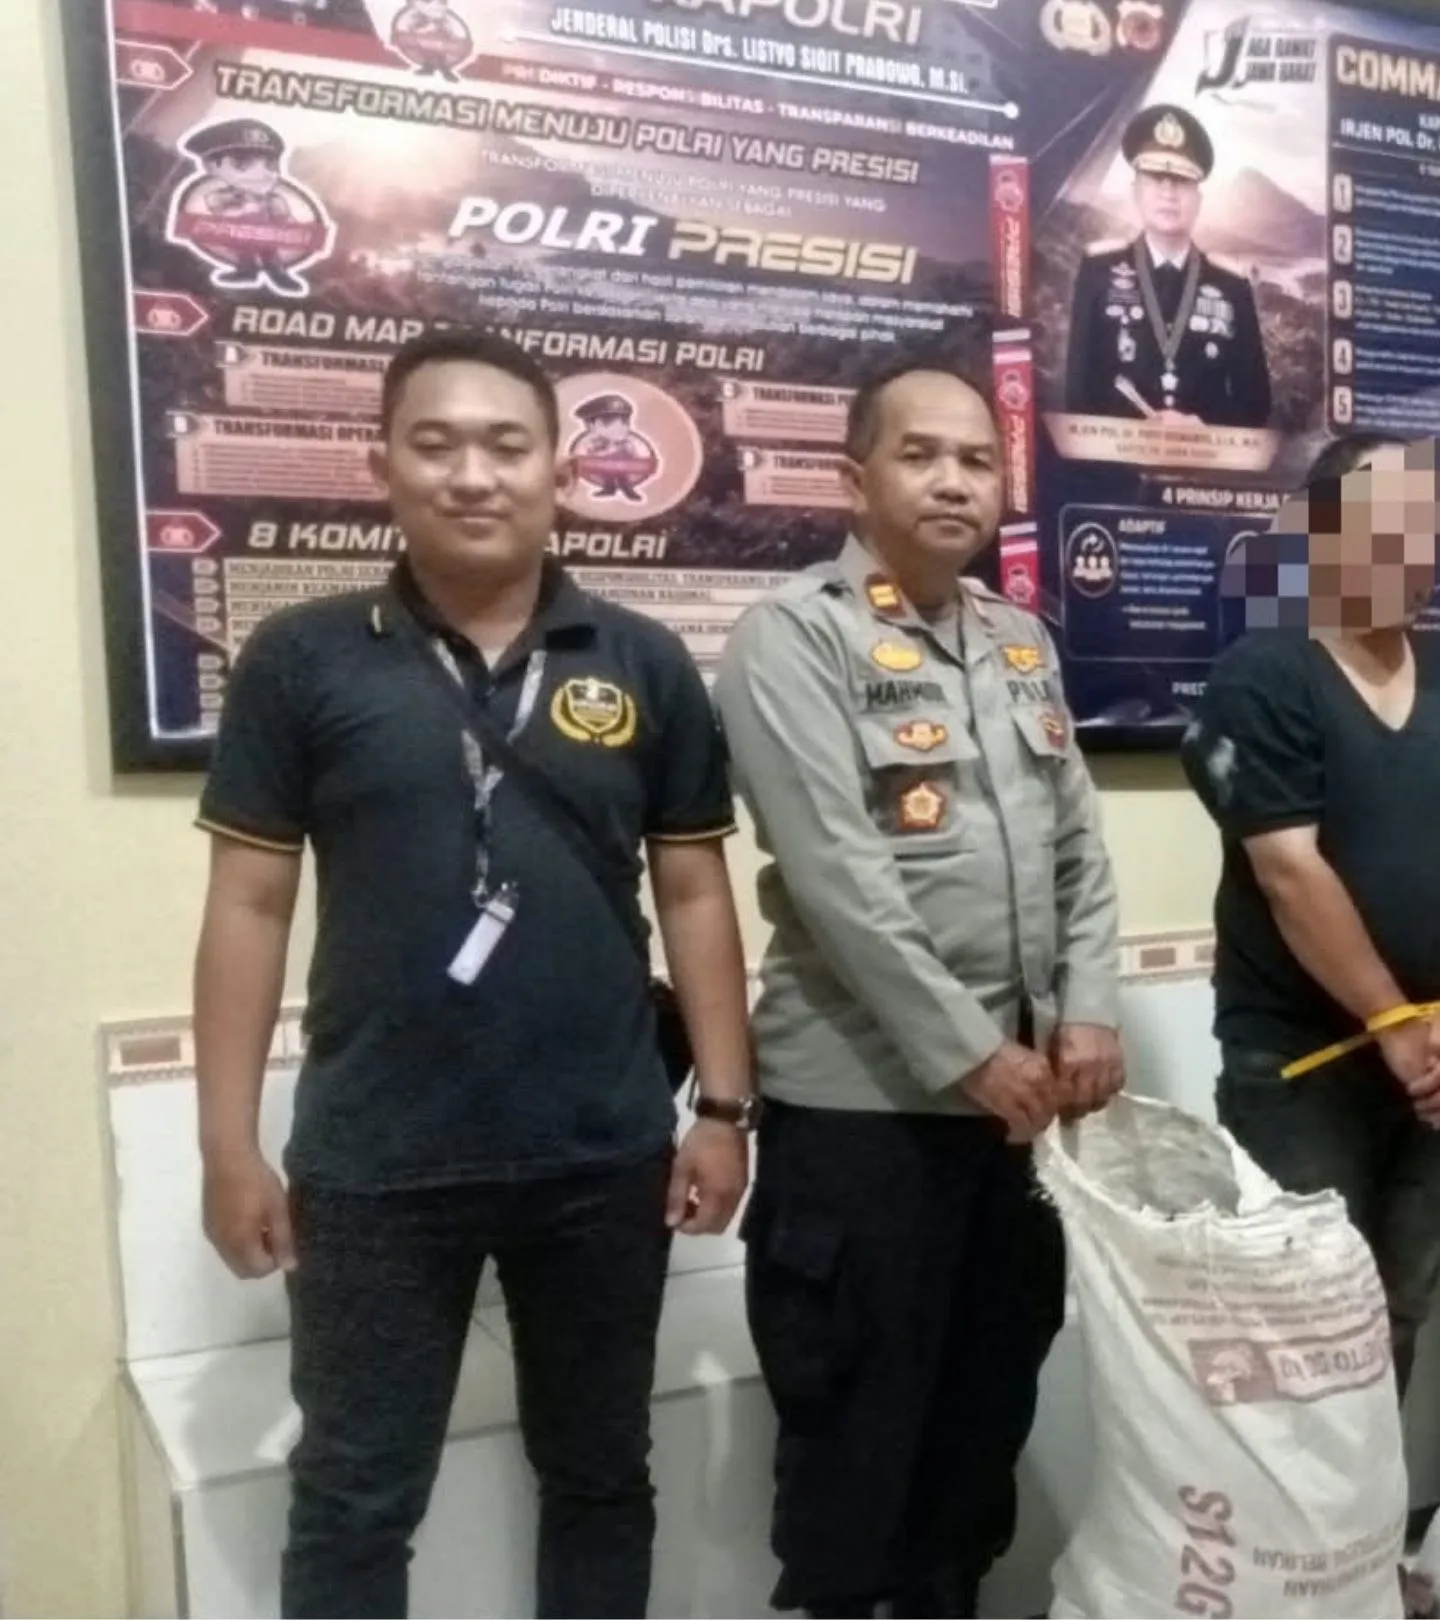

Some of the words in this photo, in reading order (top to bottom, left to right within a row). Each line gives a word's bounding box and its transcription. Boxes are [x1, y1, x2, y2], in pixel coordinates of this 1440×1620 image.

[551, 7, 637, 43] JENDERAL
[642, 20, 697, 51] POLISI
[742, 38, 796, 68] LISTYO
[216, 66, 490, 128] TRANSFORMASI
[496, 107, 629, 146] MENUJU
[636, 124, 724, 158] POLRI
[731, 134, 805, 170] YANG
[811, 146, 920, 183] PRESISI
[905, 120, 1015, 150] BERKEADILAN
[1341, 118, 1381, 143] IRJEN
[844, 195, 887, 213] YANG
[448, 196, 658, 258] POLRI
[667, 220, 918, 285] PRESISI
[232, 306, 336, 340] ROAD
[344, 315, 425, 345] MAP
[675, 340, 765, 371] POLRI
[1162, 488, 1173, 504] 4
[1176, 487, 1233, 506] PRINSIP
[249, 522, 276, 548] 8
[287, 523, 407, 551] KOMIT
[545, 531, 667, 560] APOLRI
